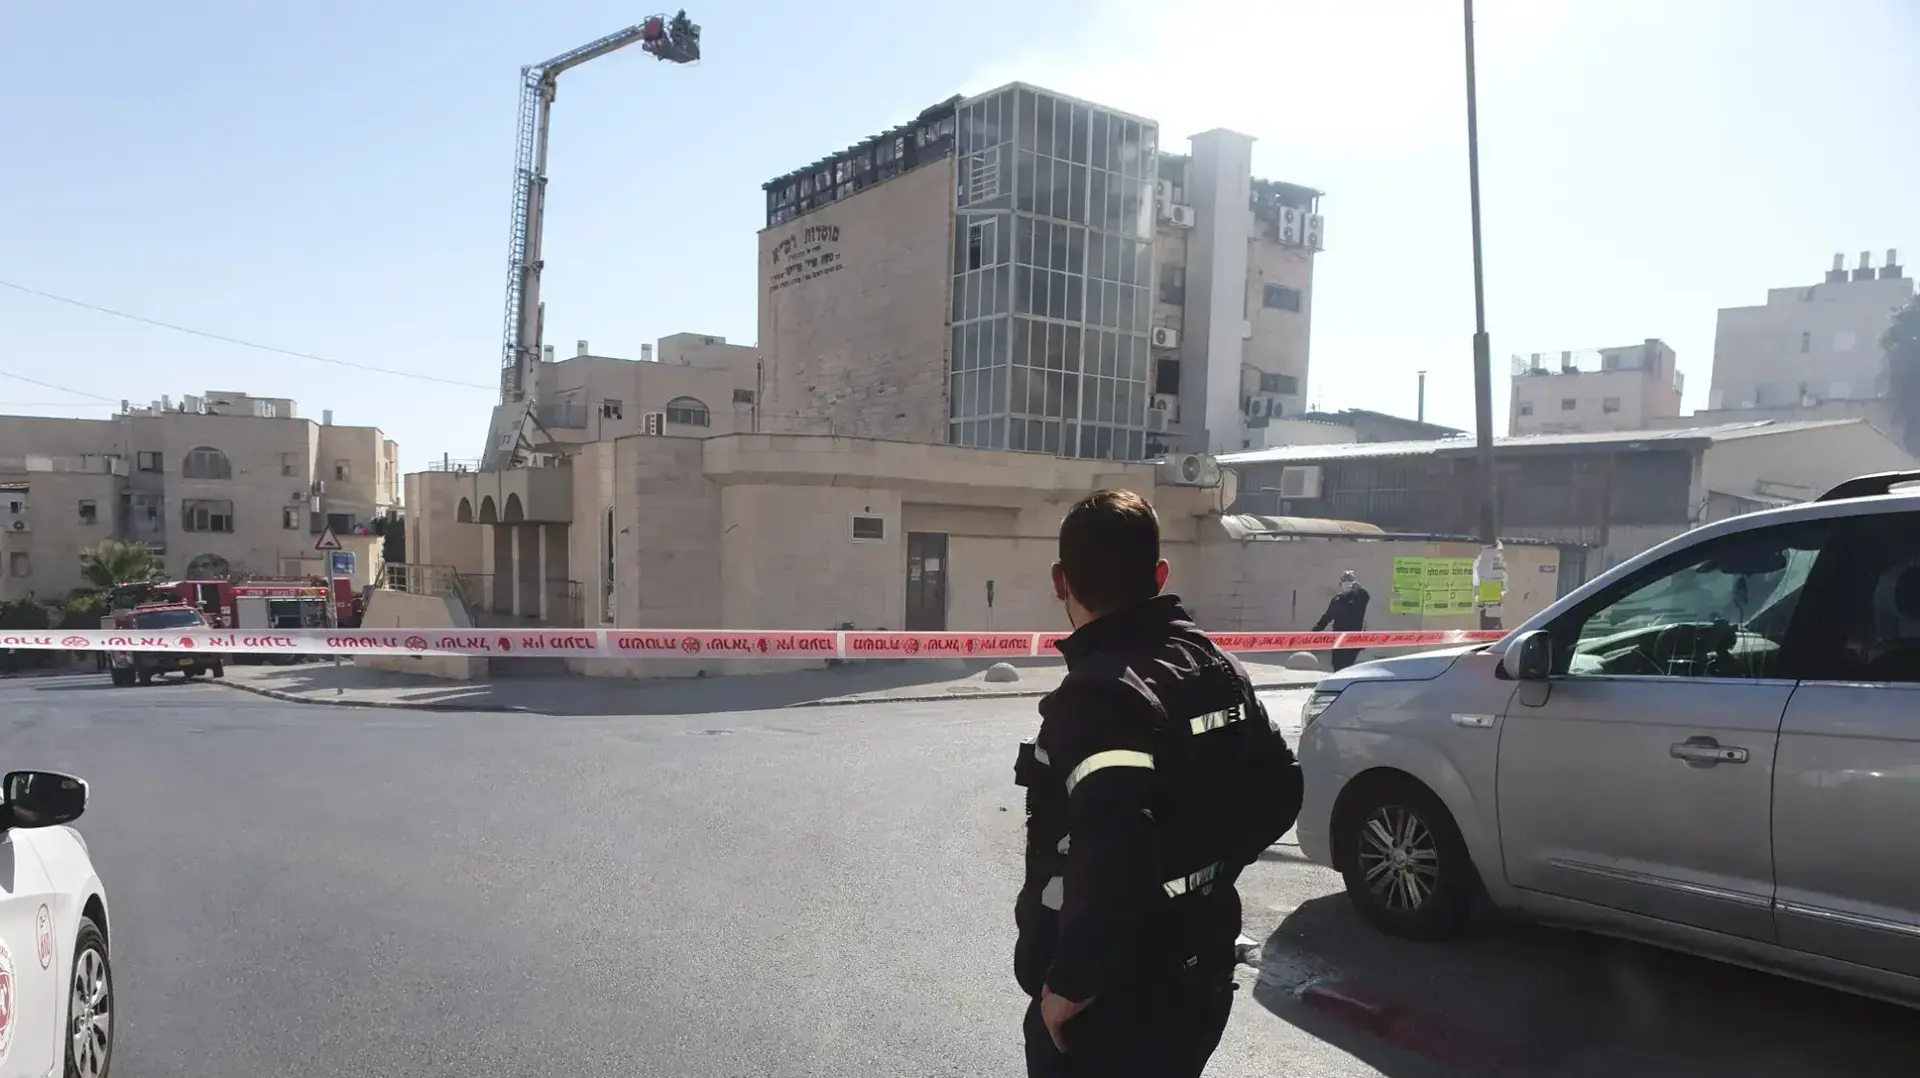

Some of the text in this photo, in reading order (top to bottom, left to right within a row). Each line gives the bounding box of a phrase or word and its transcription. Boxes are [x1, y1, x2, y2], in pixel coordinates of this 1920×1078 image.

[0, 633, 297, 648] טרת ישראל אין מעבר
[326, 634, 595, 651] משטרת ישראל אין מעבר
[618, 635, 834, 652] משטרת ישראל אין מעבר
[853, 637, 900, 650] משטרת
[923, 638, 960, 652] ישראל
